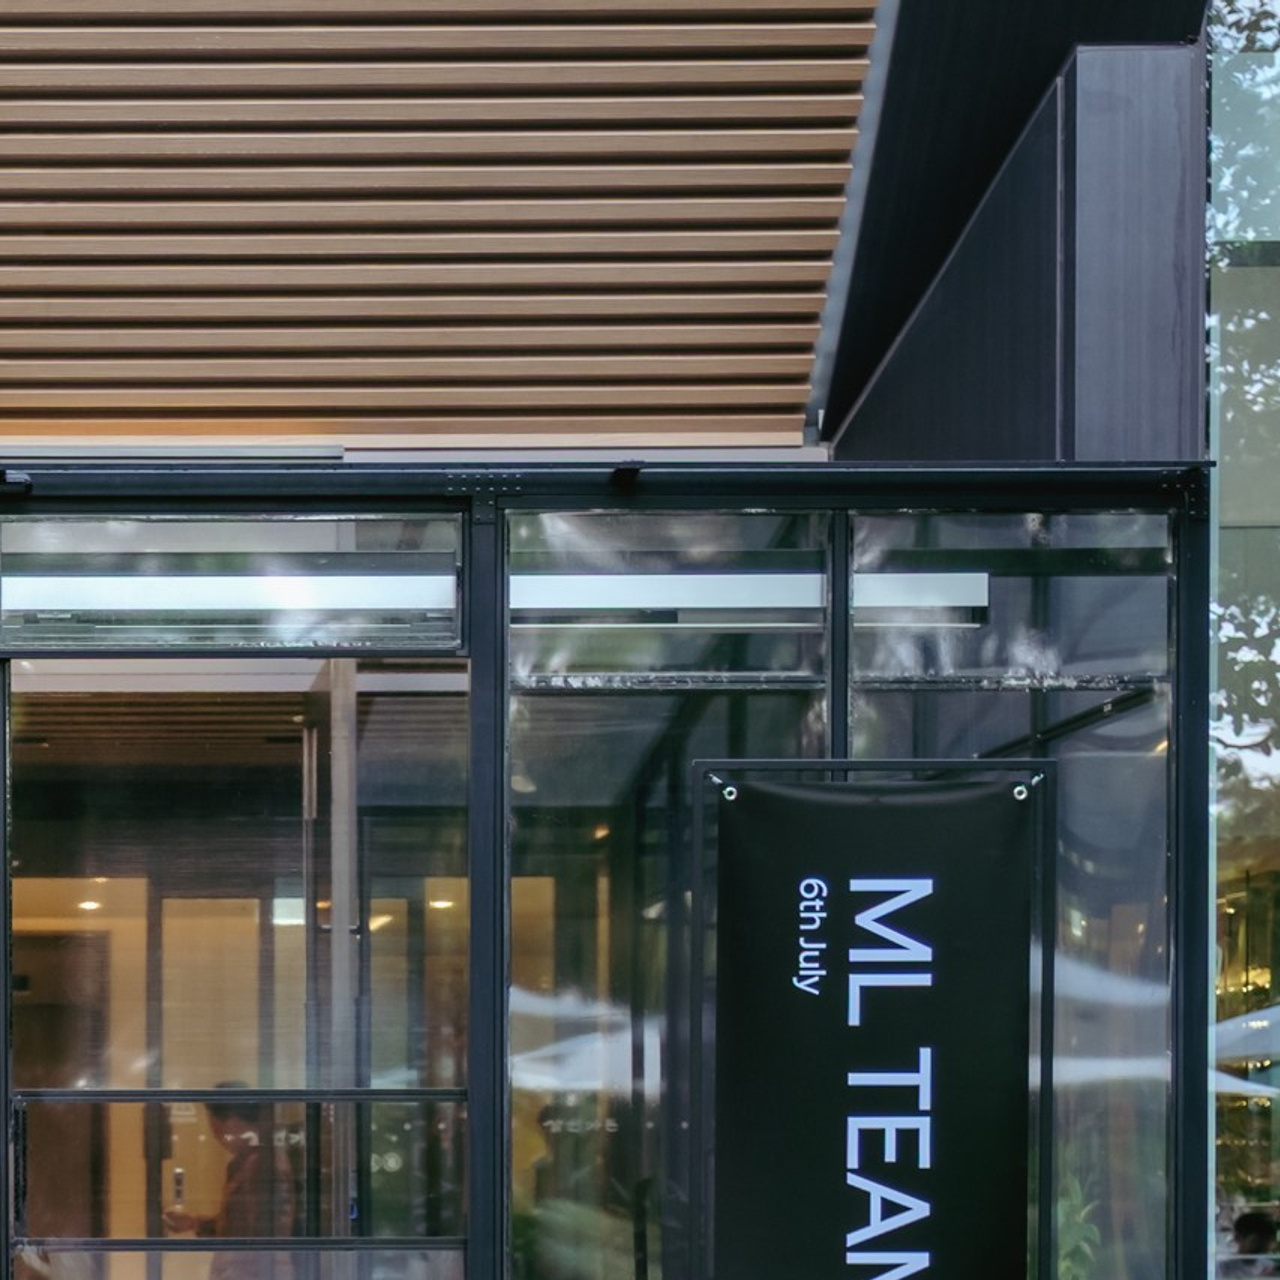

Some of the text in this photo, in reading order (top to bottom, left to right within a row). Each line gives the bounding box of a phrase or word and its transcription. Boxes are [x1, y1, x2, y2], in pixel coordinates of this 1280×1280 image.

[791, 876, 829, 997] 6th July
[847, 876, 934, 1027] ML
